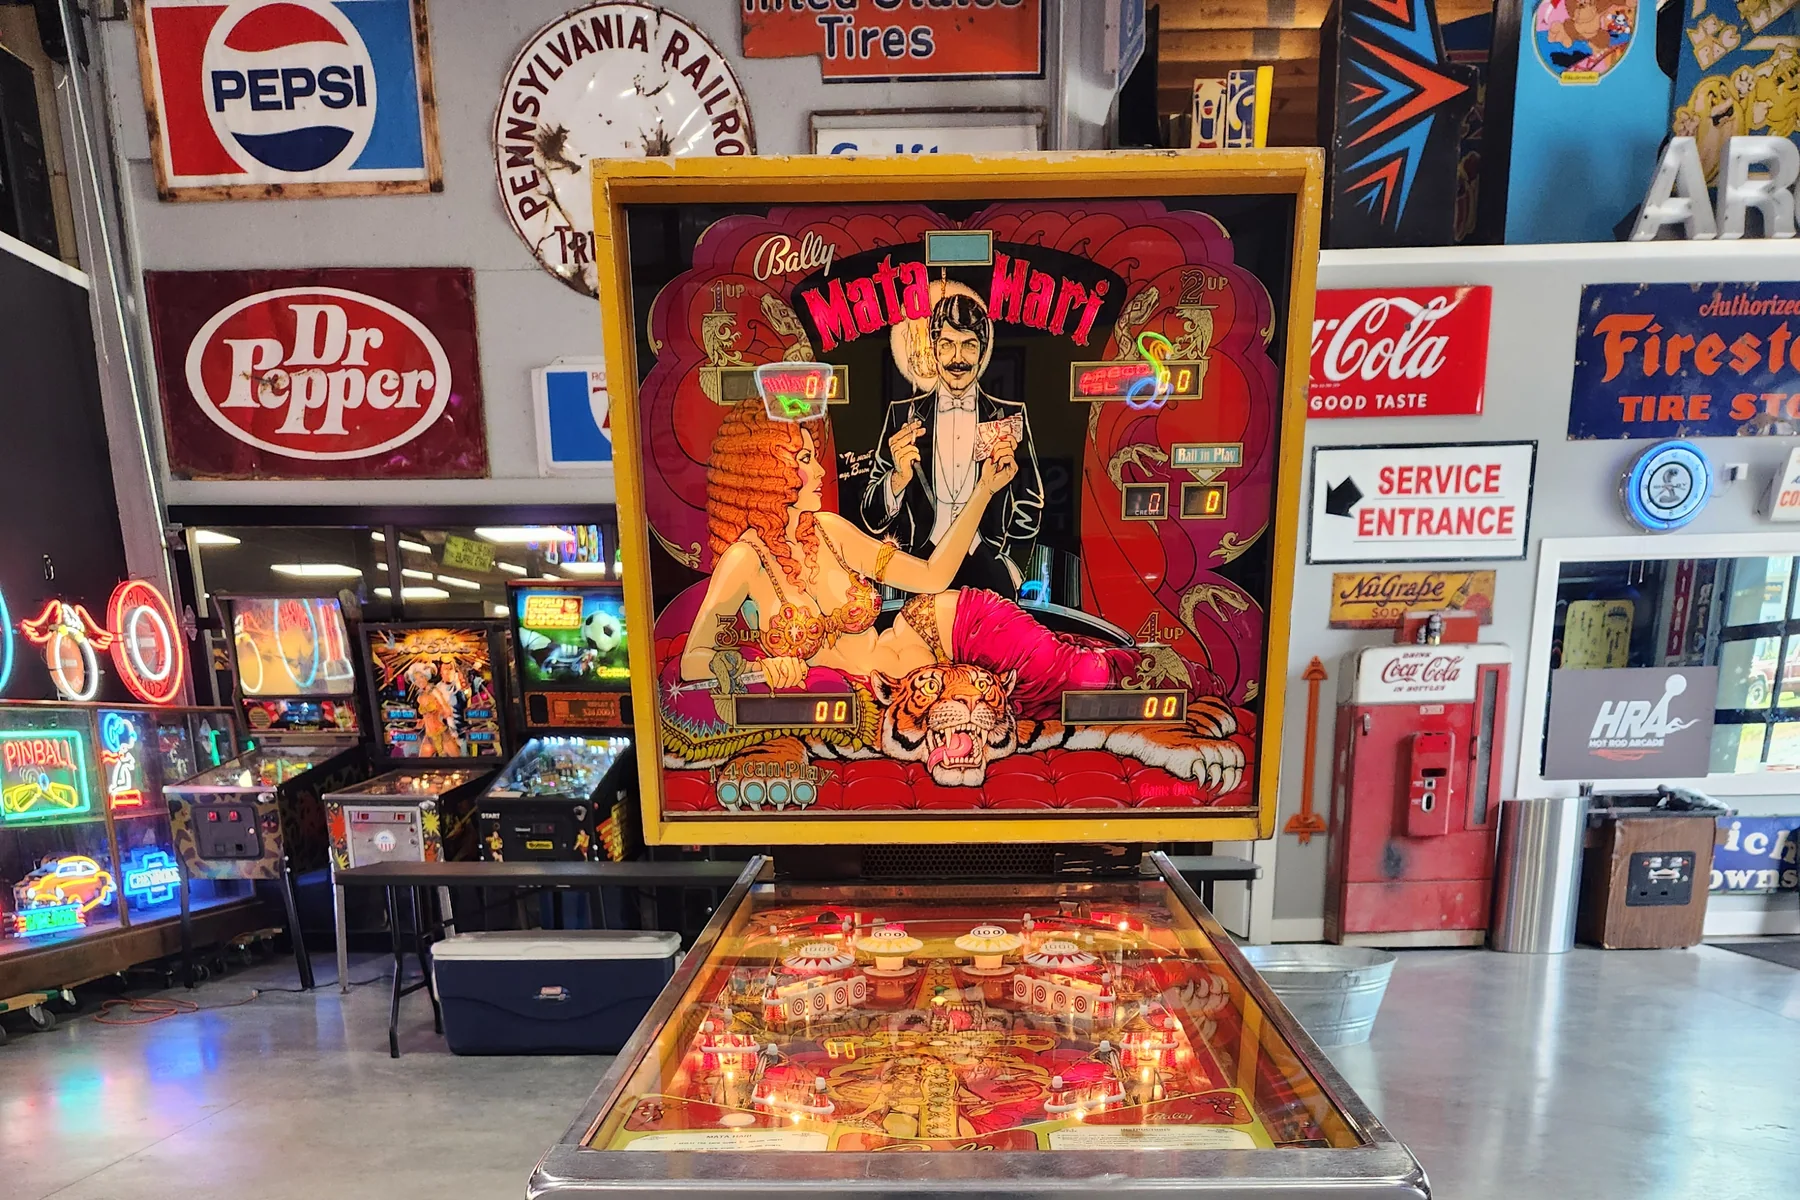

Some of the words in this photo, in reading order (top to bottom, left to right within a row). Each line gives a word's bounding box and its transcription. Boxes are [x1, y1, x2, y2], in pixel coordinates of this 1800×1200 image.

[816, 16, 935, 59] Tires
[211, 65, 367, 112] PEPSI
[505, 14, 648, 221] PENNSYLVANIA
[1629, 136, 1800, 241] AR
[753, 231, 836, 281] Bally
[711, 280, 728, 313] 1
[727, 284, 745, 298] UP
[801, 254, 932, 352] Mata
[987, 251, 1110, 347] Hari
[1181, 269, 1206, 306] 2
[1207, 277, 1229, 291] UP
[284, 304, 384, 366] Dr
[220, 339, 435, 435] Pepper
[1310, 395, 1367, 410] GOOD
[1376, 394, 1428, 410] TASTE
[1619, 395, 1712, 422] TIRE
[1178, 448, 1198, 462] Ball
[1200, 450, 1210, 462] in
[1213, 448, 1236, 465] Play
[1378, 464, 1502, 495] SERVICE
[1206, 491, 1220, 512] 0
[1780, 490, 1800, 507] CO
[1358, 506, 1516, 537] ENTRANCE
[1340, 574, 1445, 606] NuGrape
[715, 613, 740, 647] 3
[740, 629, 760, 641] UP
[1136, 611, 1161, 644] 4
[1164, 627, 1184, 640] UP
[1381, 656, 1464, 684] Coca-Cola
[815, 701, 848, 722] 00
[1144, 696, 1177, 718] 00
[1589, 700, 1667, 738] HRA
[4, 739, 78, 772] PINBALL
[1588, 738, 1608, 748] HOT
[1609, 738, 1628, 748] ROD
[1628, 738, 1664, 748] ARCADE
[743, 760, 780, 778] Can
[785, 760, 835, 787] Play
[1140, 783, 1170, 797] Game
[1172, 782, 1196, 797] Over
